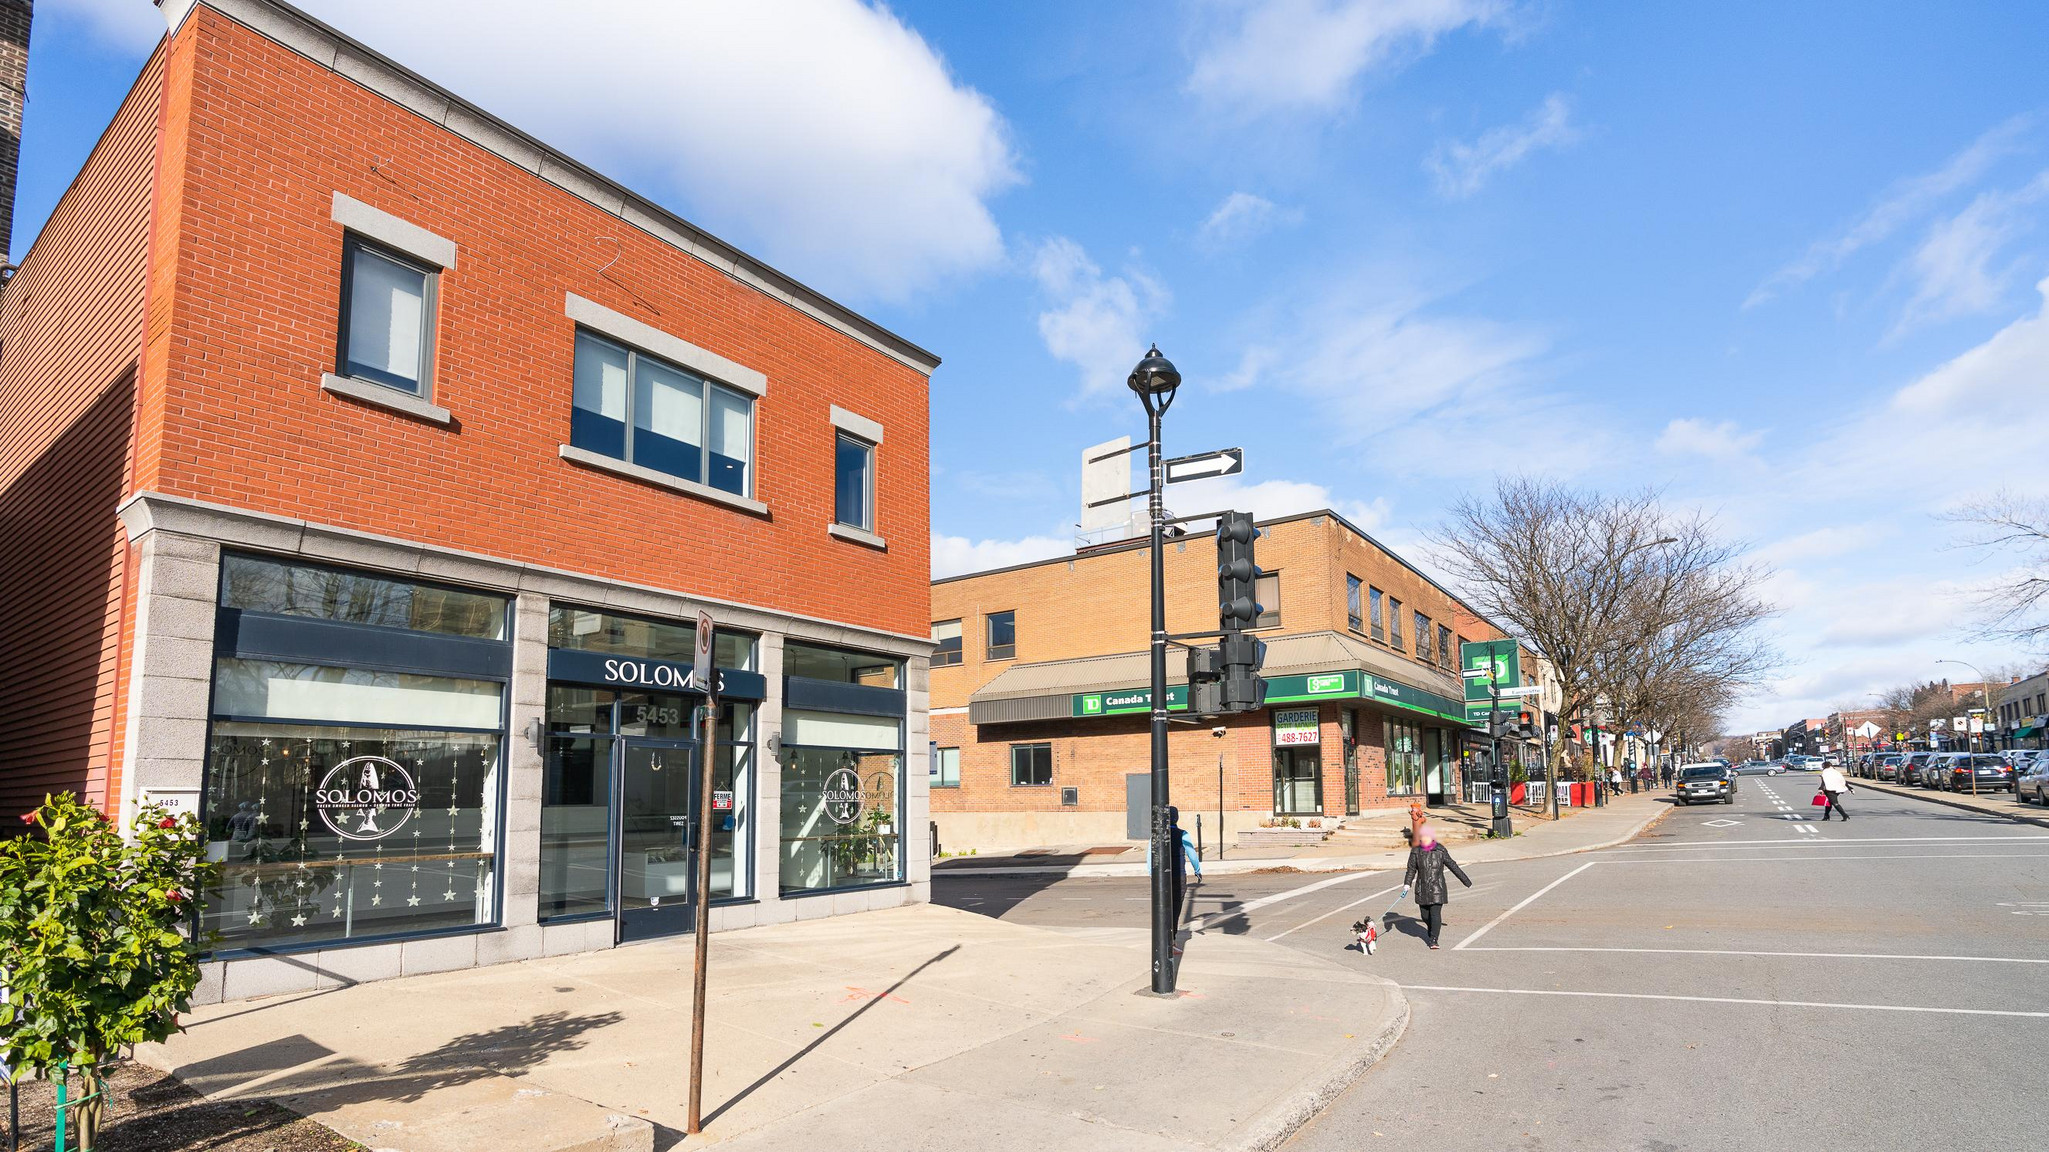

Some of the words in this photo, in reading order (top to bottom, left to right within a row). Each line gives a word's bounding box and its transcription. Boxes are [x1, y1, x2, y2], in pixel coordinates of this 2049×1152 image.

[604, 659, 725, 692] SOLOMS
[1374, 681, 1389, 693] Canada
[1388, 685, 1400, 696] Trust
[1084, 698, 1099, 711] TD
[1106, 692, 1143, 706] Canada
[1145, 691, 1175, 702] Tst
[636, 706, 679, 725] 5453
[1277, 711, 1317, 723] GARDERIE
[1281, 731, 1318, 743] 488-7627
[160, 799, 179, 807] 5453
[316, 789, 417, 804] SOLOMOS
[822, 790, 866, 801] SOLOMOS
